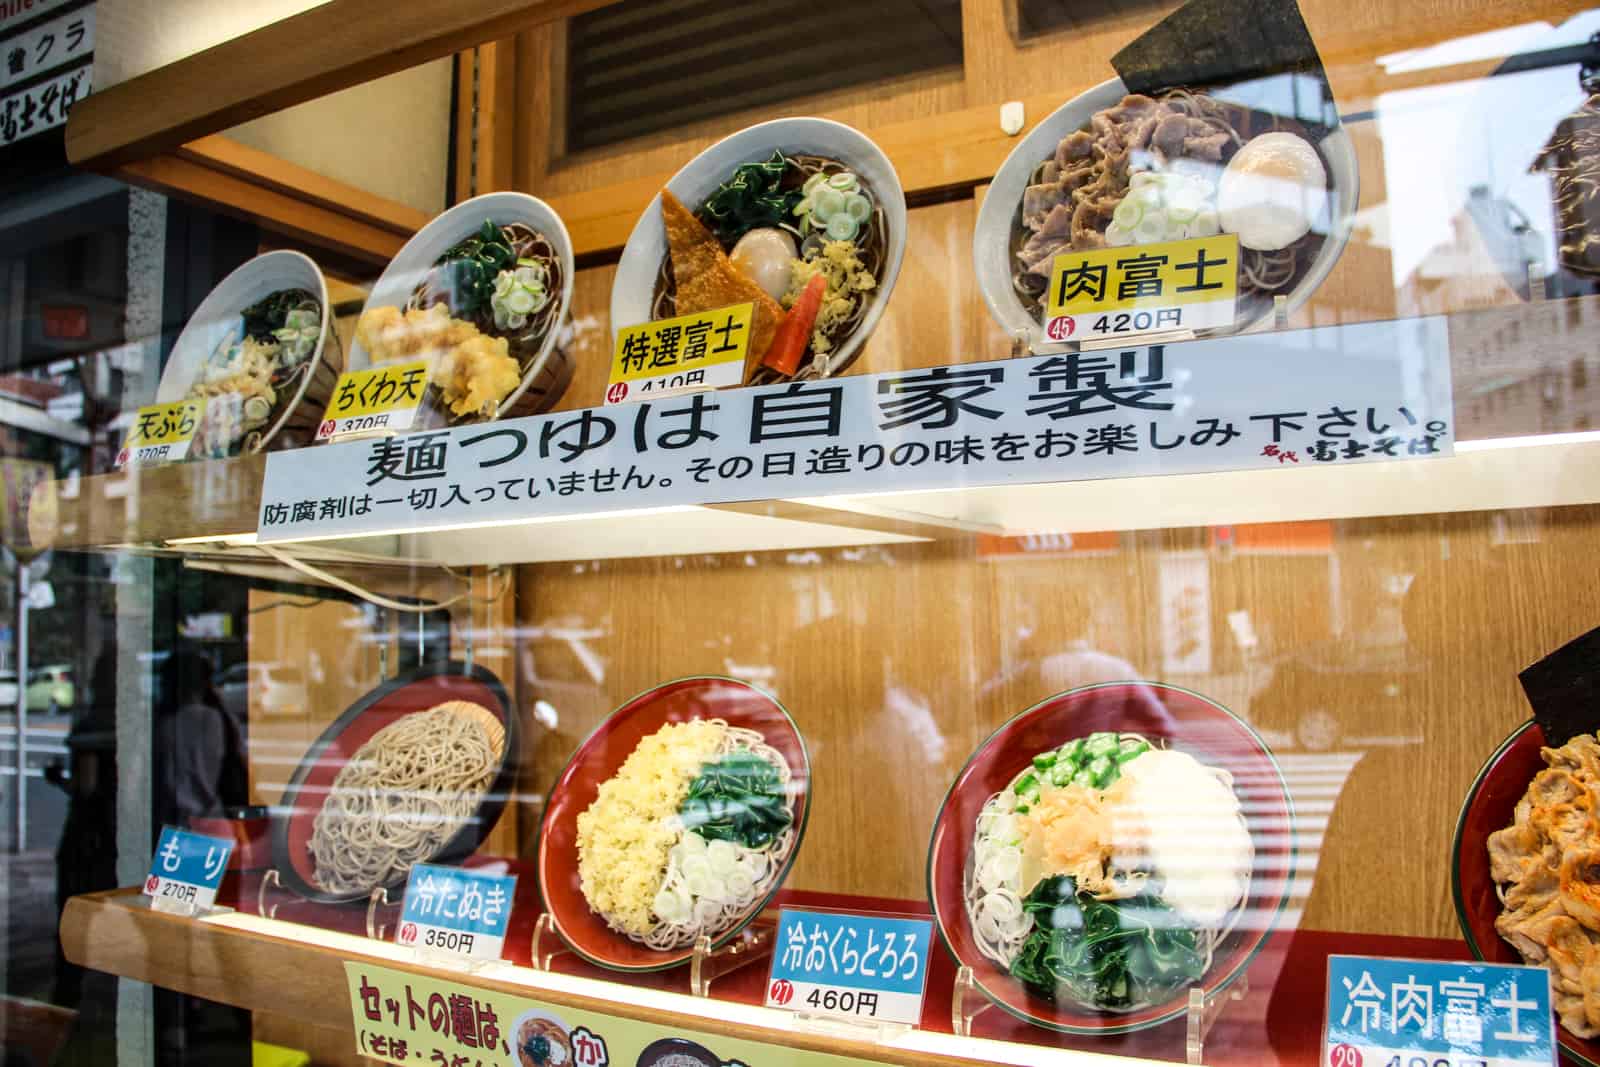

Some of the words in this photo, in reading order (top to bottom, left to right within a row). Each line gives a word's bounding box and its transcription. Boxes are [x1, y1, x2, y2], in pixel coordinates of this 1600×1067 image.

[1058, 249, 1228, 307] 肉富士
[1050, 316, 1074, 340] 45
[1092, 307, 1182, 334] 420円
[621, 315, 743, 374] 特選富士
[337, 368, 426, 411] ちくわ天
[132, 405, 196, 440] 天ぷら
[366, 345, 1175, 487] 麺つゆは自家製
[1260, 444, 1299, 464] 名代
[1306, 431, 1447, 463] 富士そば
[160, 835, 228, 881] もり
[162, 882, 198, 903] 270円
[410, 874, 507, 926] 冷たぬき
[425, 929, 475, 954] 350円
[781, 921, 919, 981] 冷おくらとろろ
[772, 979, 792, 1005] 27
[806, 988, 879, 1017] 460円
[1340, 970, 1539, 1044] 冷肉富士
[359, 975, 511, 1056] セットの麺は、
